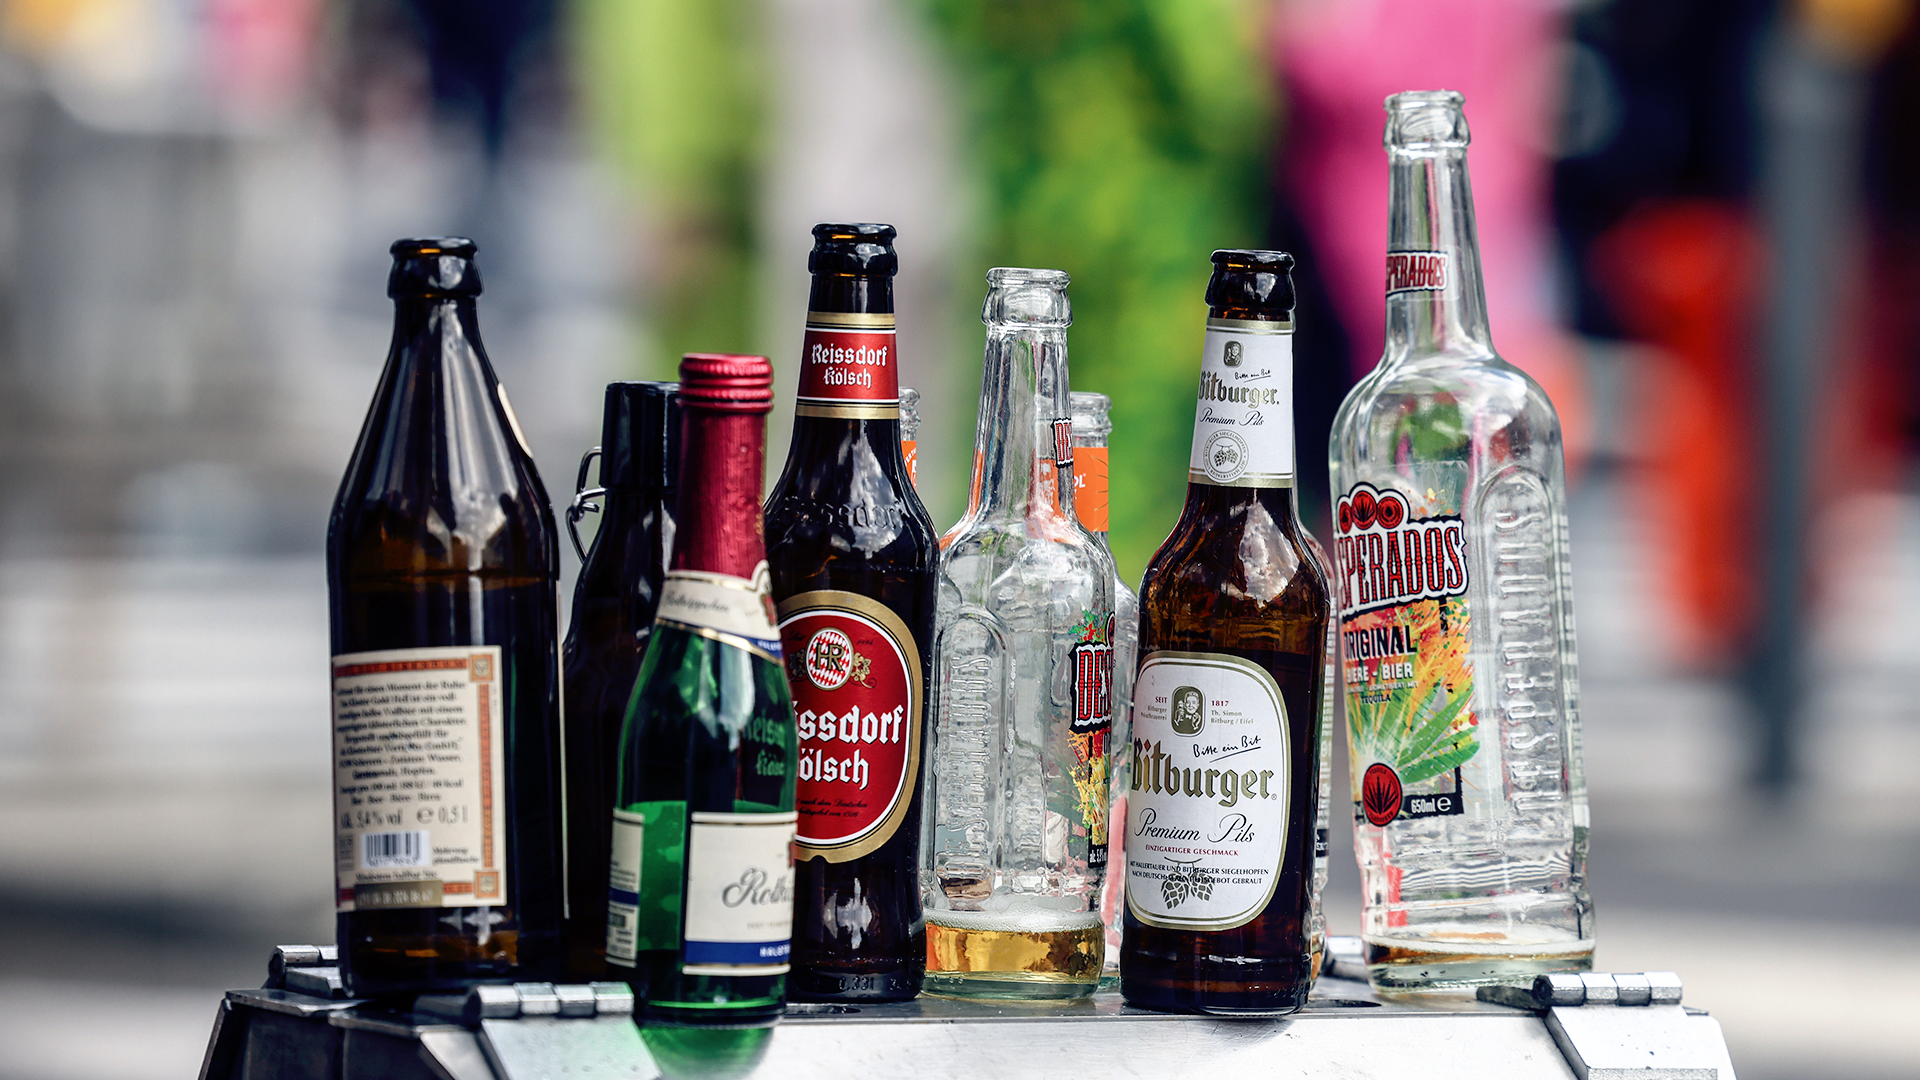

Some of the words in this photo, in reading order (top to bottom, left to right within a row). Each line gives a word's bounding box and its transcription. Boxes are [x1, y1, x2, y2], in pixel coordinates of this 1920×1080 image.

[811, 343, 888, 367] Reissdorf
[823, 366, 872, 389] Kölsch
[1198, 370, 1279, 409] Bitburger
[1199, 406, 1236, 425] Premium
[1239, 410, 1265, 426] Pils
[815, 643, 844, 672] HR
[1382, 662, 1414, 680] BIER
[793, 701, 904, 744] ssdorf
[1210, 717, 1234, 726] Bitburg
[1222, 709, 1243, 717] Simon
[1193, 743, 1218, 758] Bitte
[1222, 744, 1239, 752] ein
[1241, 735, 1262, 748] Bit
[796, 748, 869, 790] ölsch
[1131, 737, 1275, 808] Bitburger
[1411, 798, 1436, 814] 650ml
[1134, 807, 1201, 841] Premium
[1207, 813, 1255, 843] Pils
[1145, 844, 1191, 854] EINZIGARTIGER
[1193, 848, 1239, 856] GESCHMACK
[1232, 877, 1262, 885] GEBRAUT
